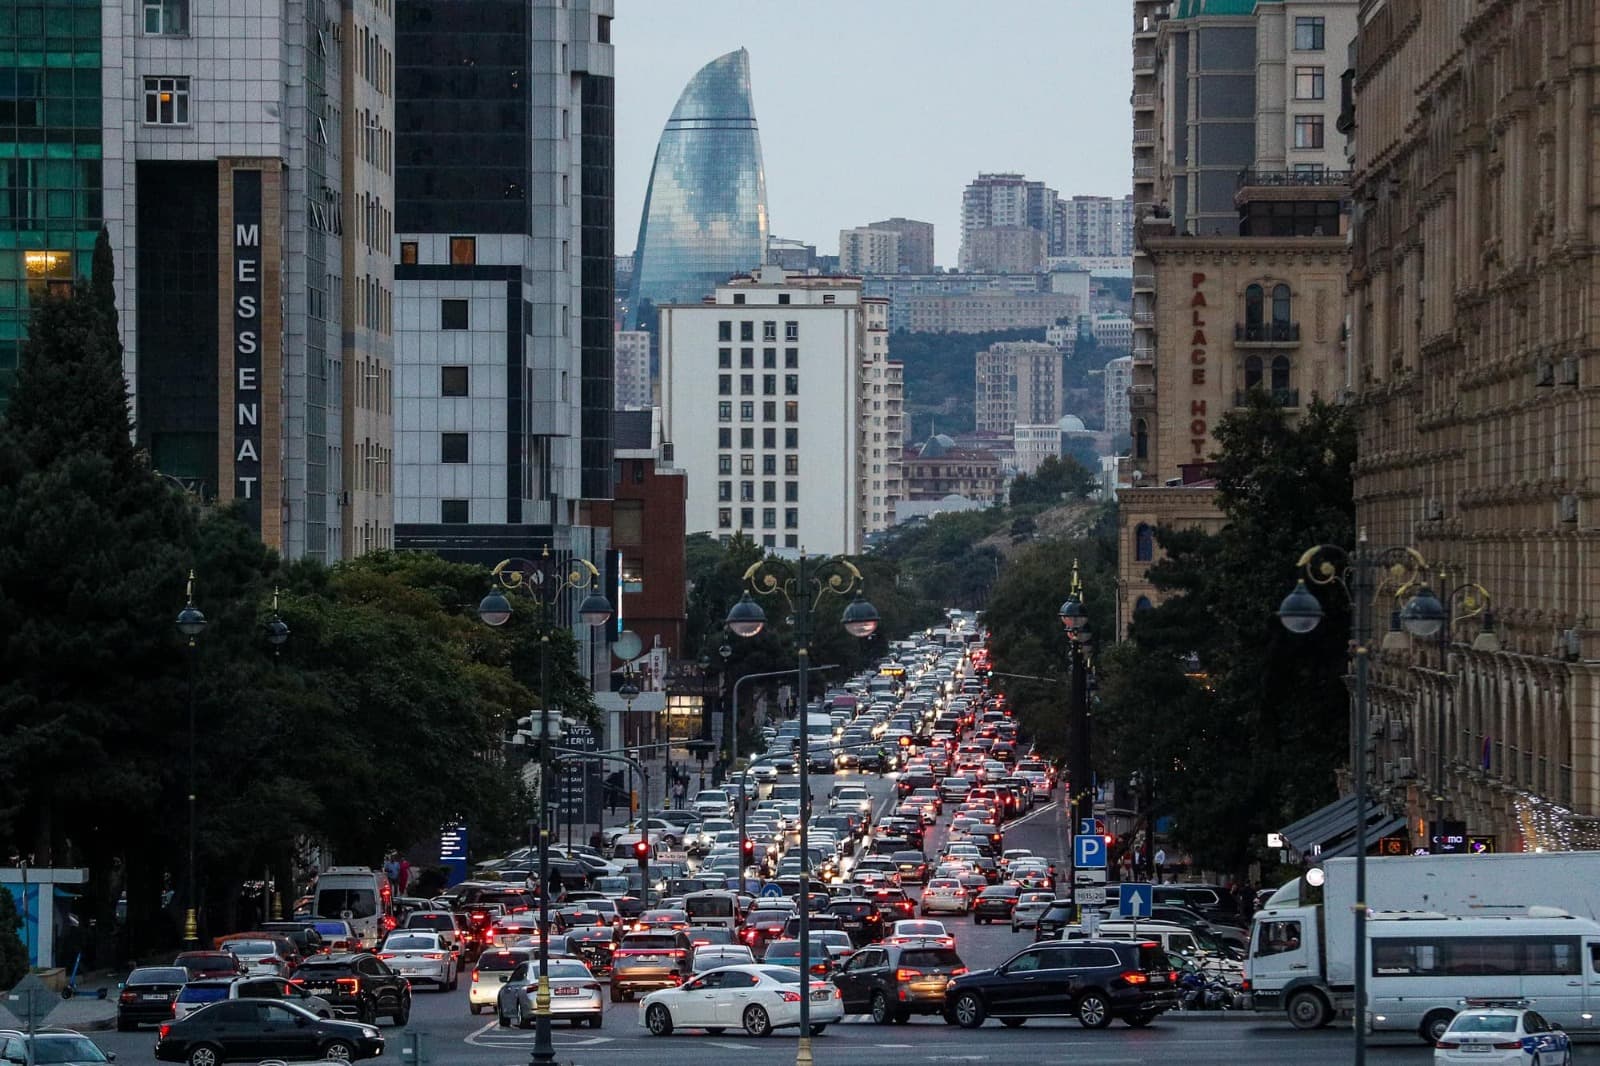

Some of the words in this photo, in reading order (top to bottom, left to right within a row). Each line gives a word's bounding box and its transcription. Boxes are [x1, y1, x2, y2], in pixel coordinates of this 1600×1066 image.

[236, 223, 259, 499] MESSENAT
[1191, 272, 1207, 385] PALACE
[1082, 839, 1099, 864] P
